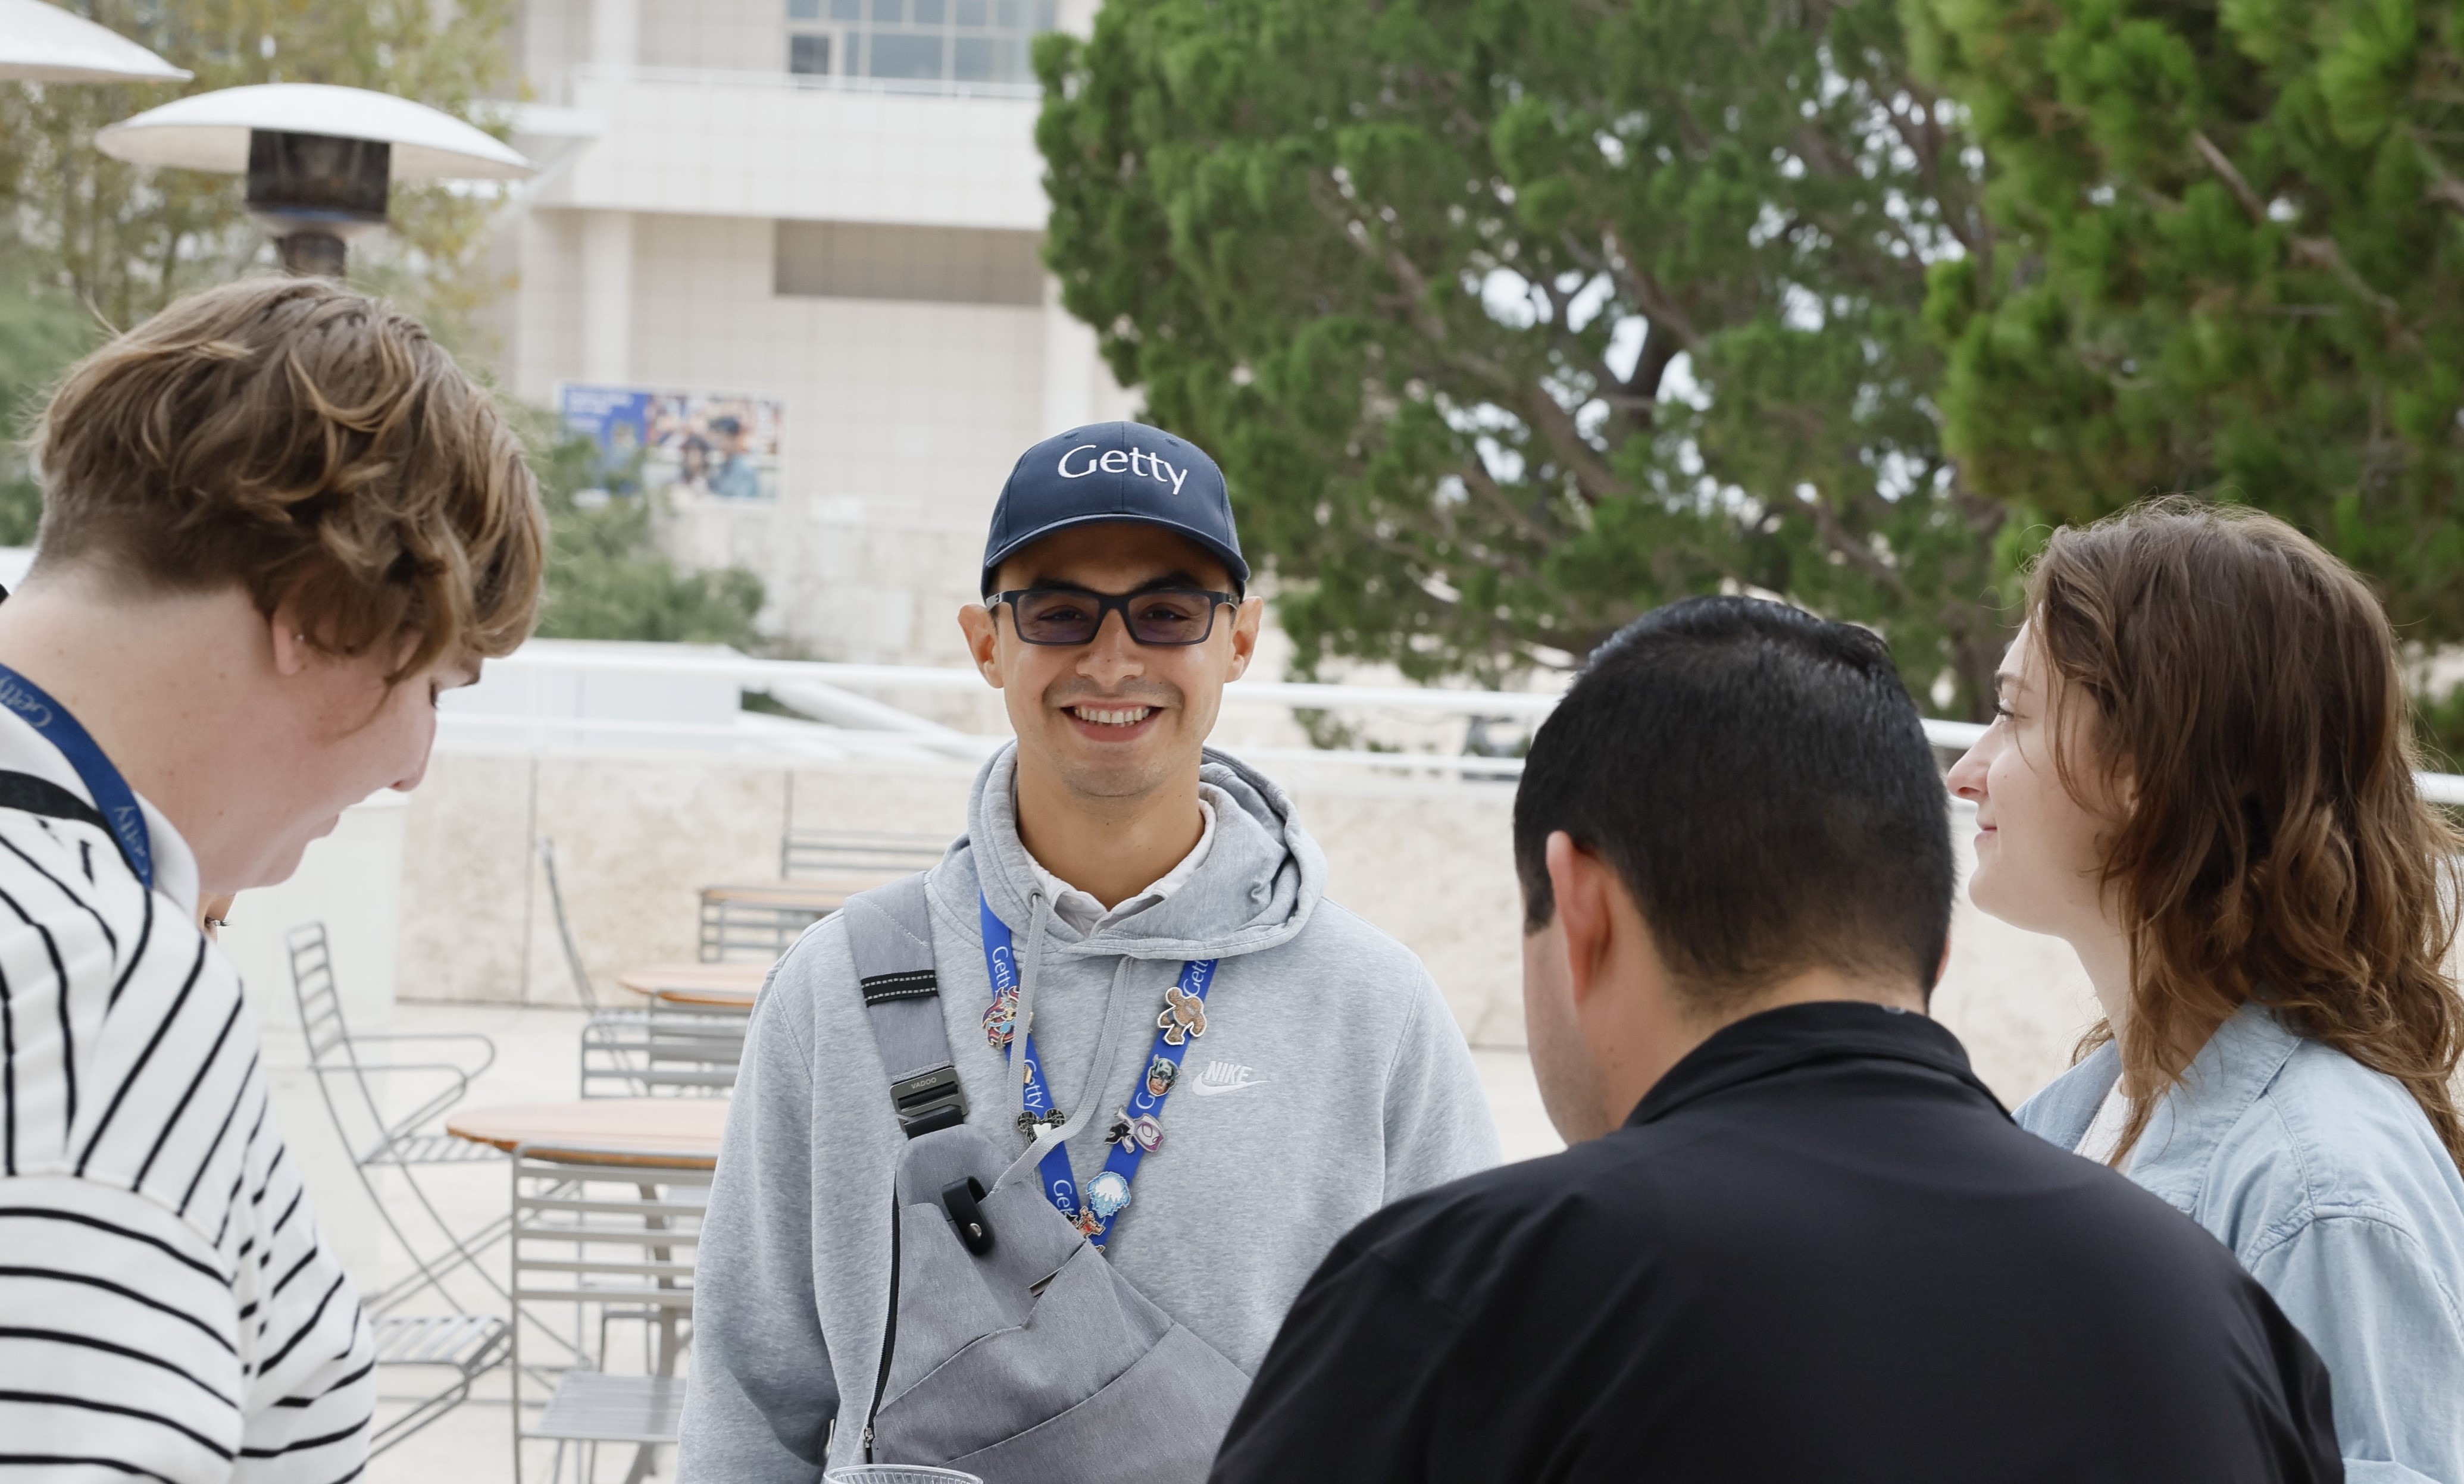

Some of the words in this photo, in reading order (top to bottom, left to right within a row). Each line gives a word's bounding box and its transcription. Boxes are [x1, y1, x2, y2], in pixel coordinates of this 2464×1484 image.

[1058, 444, 1188, 496] Getty
[1183, 959, 1214, 996] Gett
[911, 1077, 937, 1089] VADOO
[1204, 1060, 1253, 1084] NIKE
